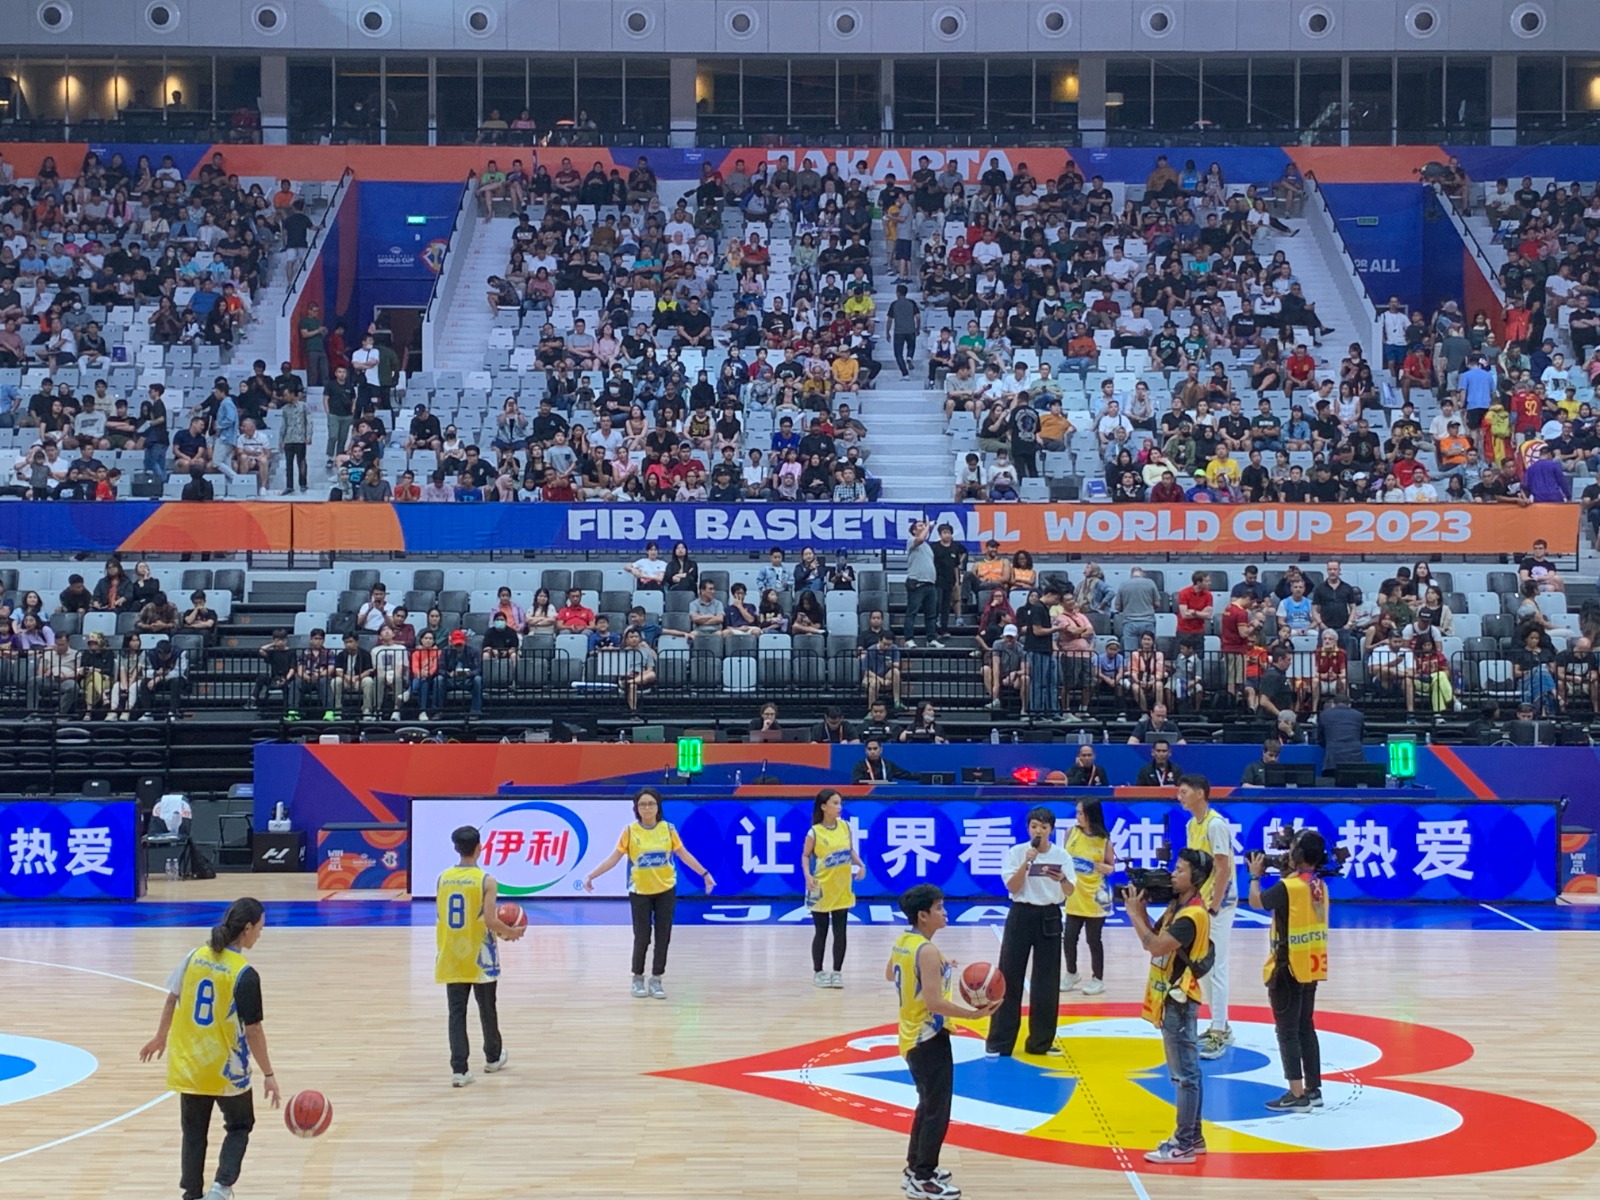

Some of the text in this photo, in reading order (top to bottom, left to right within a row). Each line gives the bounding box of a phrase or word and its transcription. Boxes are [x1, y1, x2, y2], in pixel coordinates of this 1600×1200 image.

[767, 150, 1015, 184] JAKARTA
[1369, 259, 1400, 273] ALL
[1524, 400, 1538, 416] 92
[567, 508, 683, 541] FIBA
[1043, 510, 1220, 542] WORLD
[1232, 510, 1332, 542] CUP
[1345, 510, 1472, 543] 2023
[9, 827, 114, 876] 热爱
[327, 849, 344, 857] WIN
[481, 830, 569, 867] 伊利
[448, 893, 466, 929] 8
[194, 978, 214, 1027] 8
